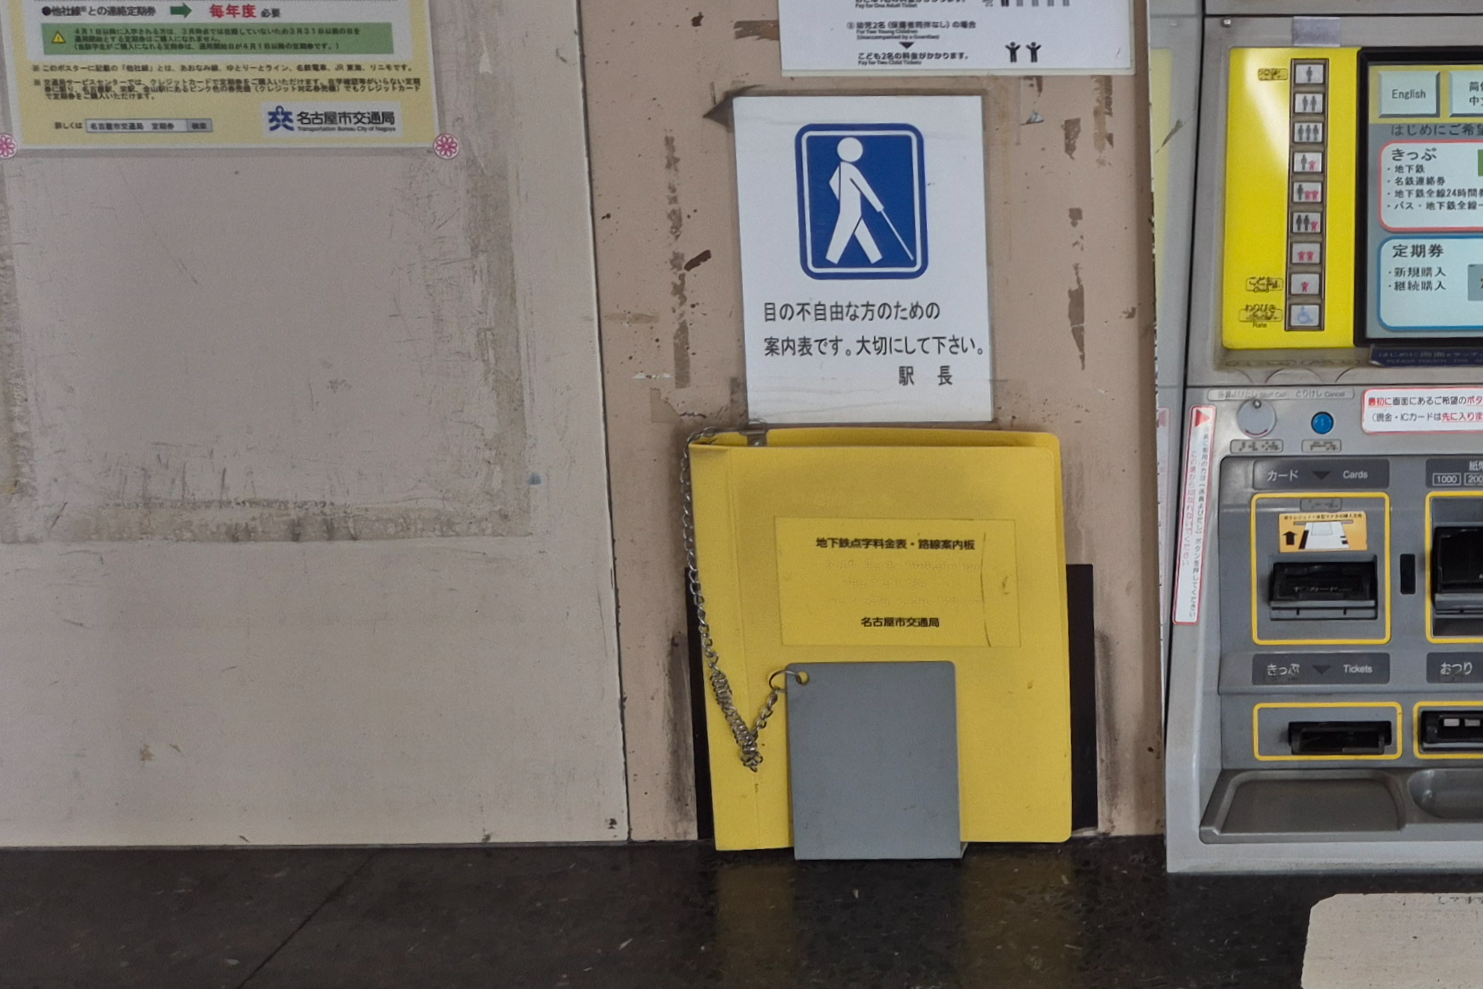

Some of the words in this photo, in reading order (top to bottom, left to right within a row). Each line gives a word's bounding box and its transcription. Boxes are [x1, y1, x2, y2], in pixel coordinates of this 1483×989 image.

[210, 4, 256, 18] 毎年度
[1392, 89, 1426, 100] English
[297, 111, 394, 125] 名古屋市交通局
[1392, 148, 1436, 161] きっぷ
[1393, 244, 1443, 258] 定期券
[1395, 267, 1446, 277] 新規購入
[765, 301, 940, 322] 目の不自由な方のための
[764, 335, 982, 356] 案内表です。大切にして下さい。
[899, 366, 914, 386] 駅
[938, 366, 952, 385] 長
[1266, 467, 1297, 482] カード
[1343, 470, 1368, 479] Cards
[816, 538, 974, 550] 地下鉄点字料金表・路線案内板
[861, 617, 939, 627] 名古屋市交通局
[1268, 663, 1299, 675] きっぷ
[1344, 665, 1372, 673] Tickets
[1441, 662, 1472, 675] おつり
